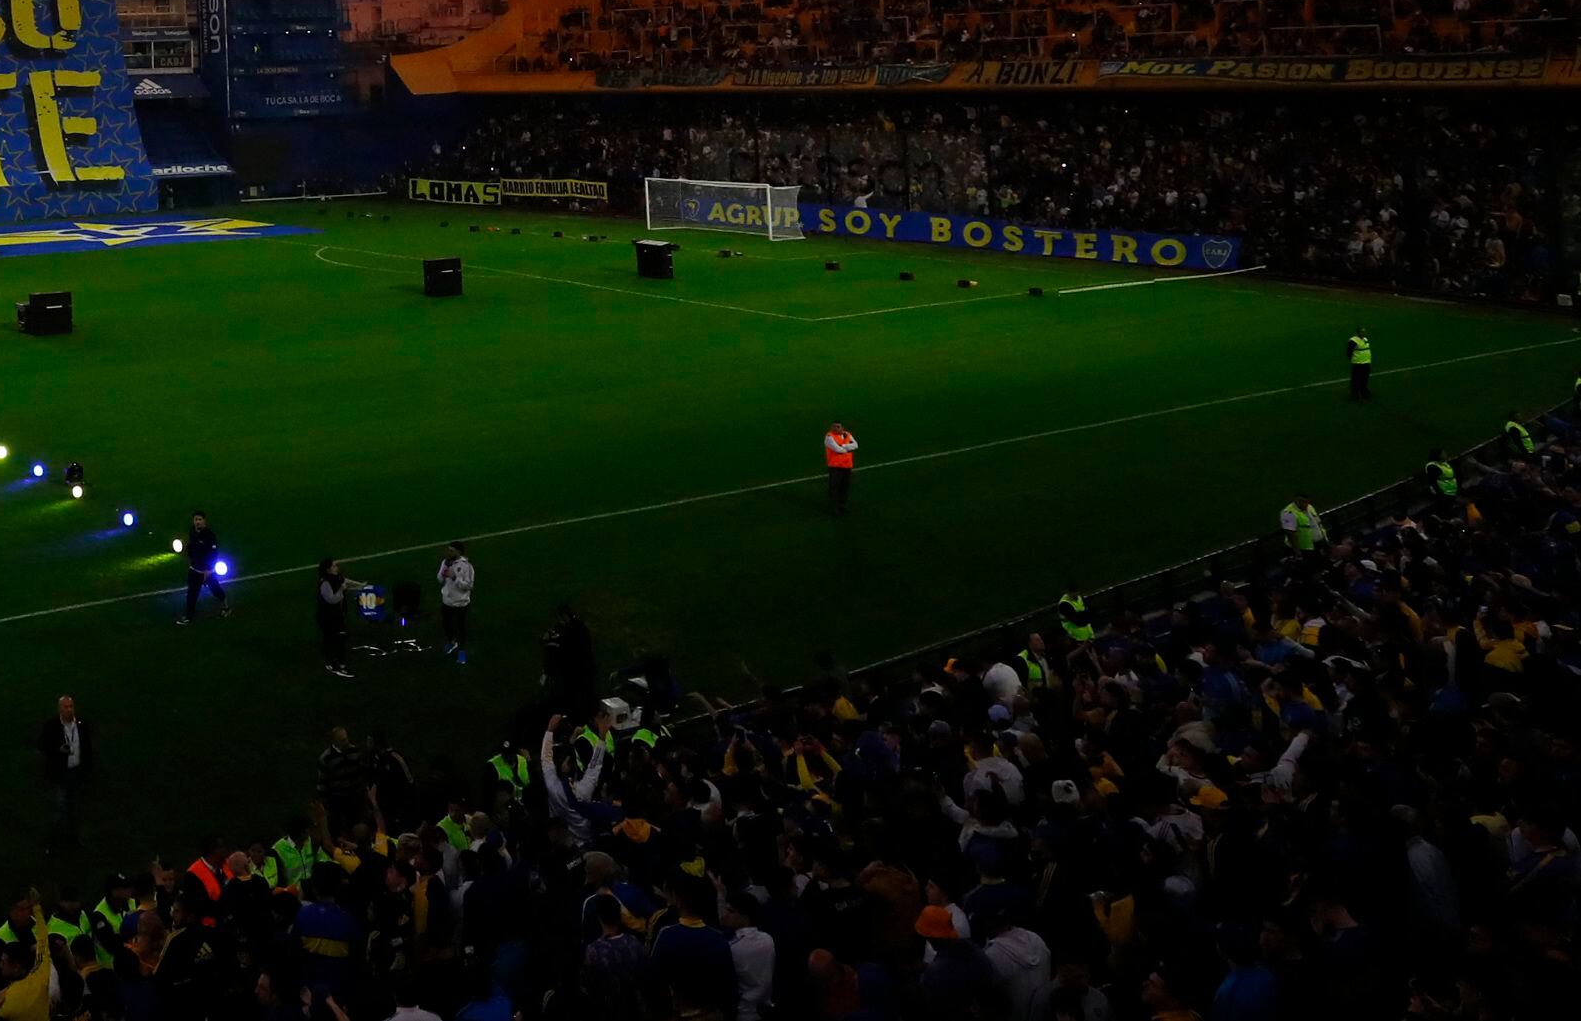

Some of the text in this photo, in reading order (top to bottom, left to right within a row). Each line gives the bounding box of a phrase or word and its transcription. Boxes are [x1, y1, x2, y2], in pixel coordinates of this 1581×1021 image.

[1207, 60, 1335, 80] PASION
[410, 179, 500, 204] LOMAS
[502, 181, 534, 194] BARRIO
[534, 181, 568, 195] FAMILIA
[818, 209, 903, 239] SOY
[930, 216, 1188, 266] BOSTERO
